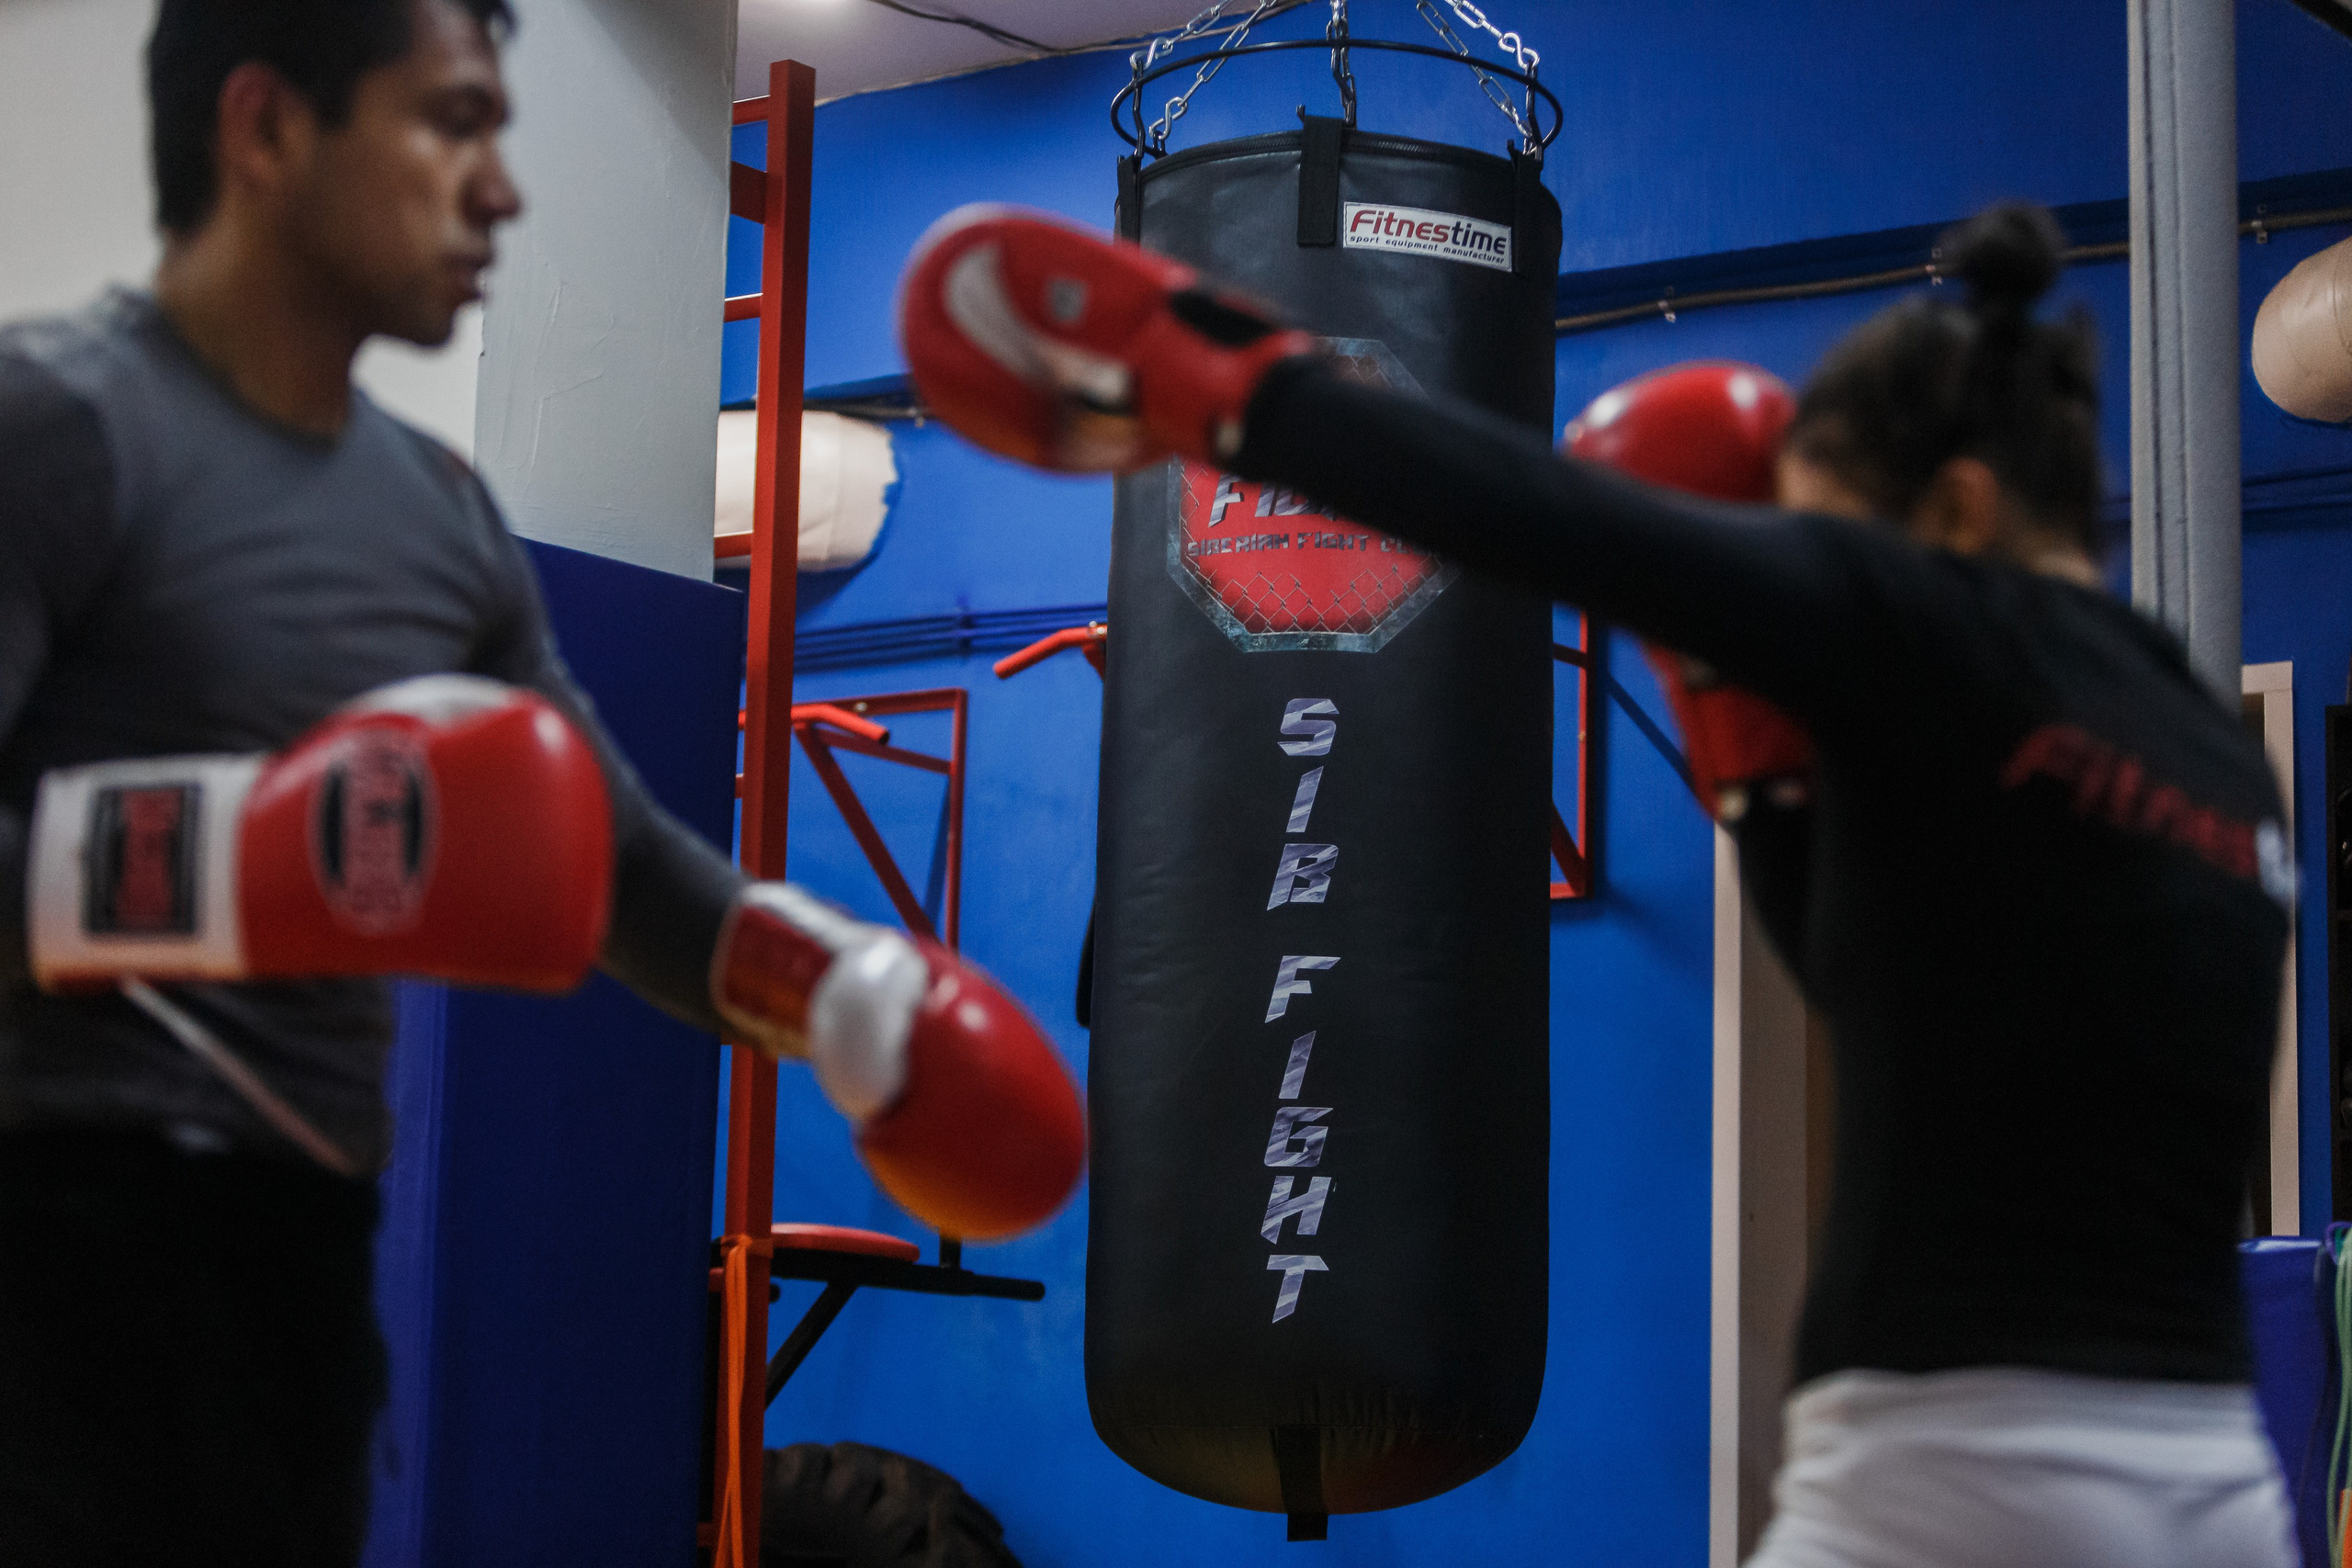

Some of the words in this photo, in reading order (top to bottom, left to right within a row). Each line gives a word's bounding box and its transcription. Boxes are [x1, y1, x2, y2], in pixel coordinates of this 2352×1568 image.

[1350, 209, 1507, 255] Fitnestime
[1350, 235, 1380, 243] sport
[1385, 239, 1438, 252] equipment
[1442, 246, 1505, 265] manufacturer
[1187, 532, 1290, 558] SIBERIAN
[1297, 530, 1371, 552] FIGHT
[1266, 697, 1340, 910] SIB
[1261, 954, 1342, 1325] FIGHT
